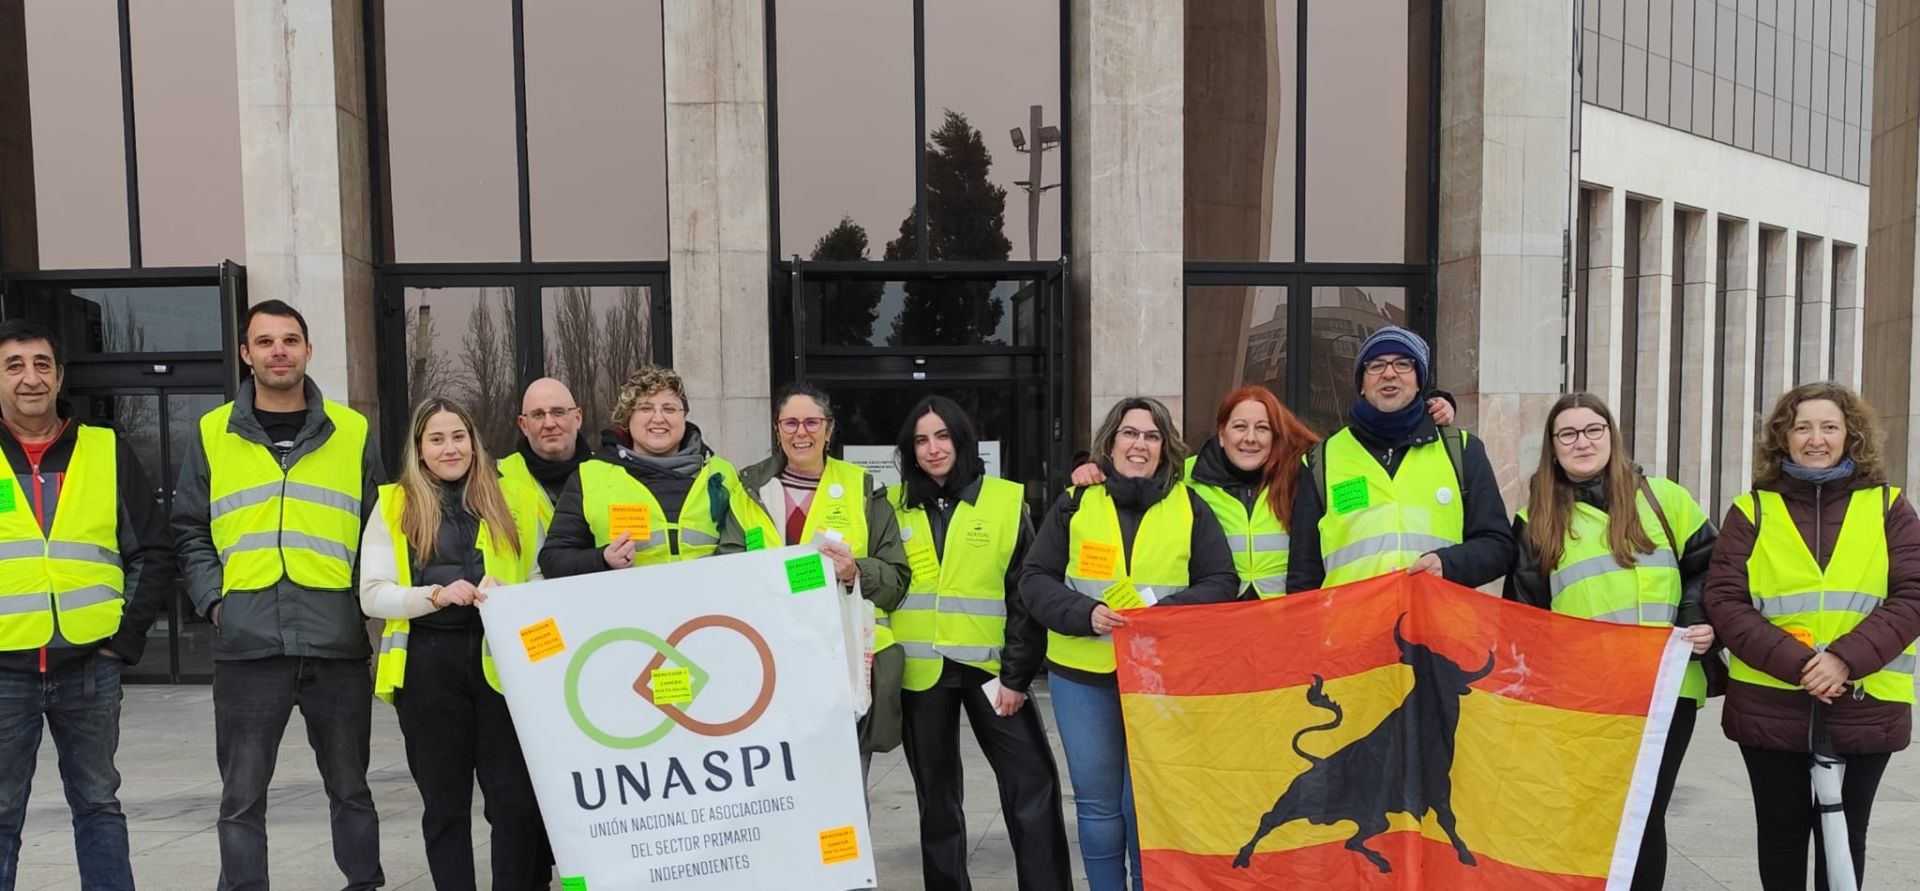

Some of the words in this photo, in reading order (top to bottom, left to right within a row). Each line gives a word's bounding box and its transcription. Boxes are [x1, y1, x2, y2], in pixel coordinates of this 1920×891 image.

[571, 741, 796, 811] UNASPI
[589, 817, 628, 838] UNIÓN
[631, 811, 688, 832] NACIONAL
[691, 807, 706, 824] DE
[708, 796, 795, 821] ASOCIACIONES
[631, 842, 653, 859] DEL
[655, 834, 701, 855] SECTOR
[703, 826, 761, 849] PRIMARIO
[649, 854, 750, 883] INDEPENDIENTES
